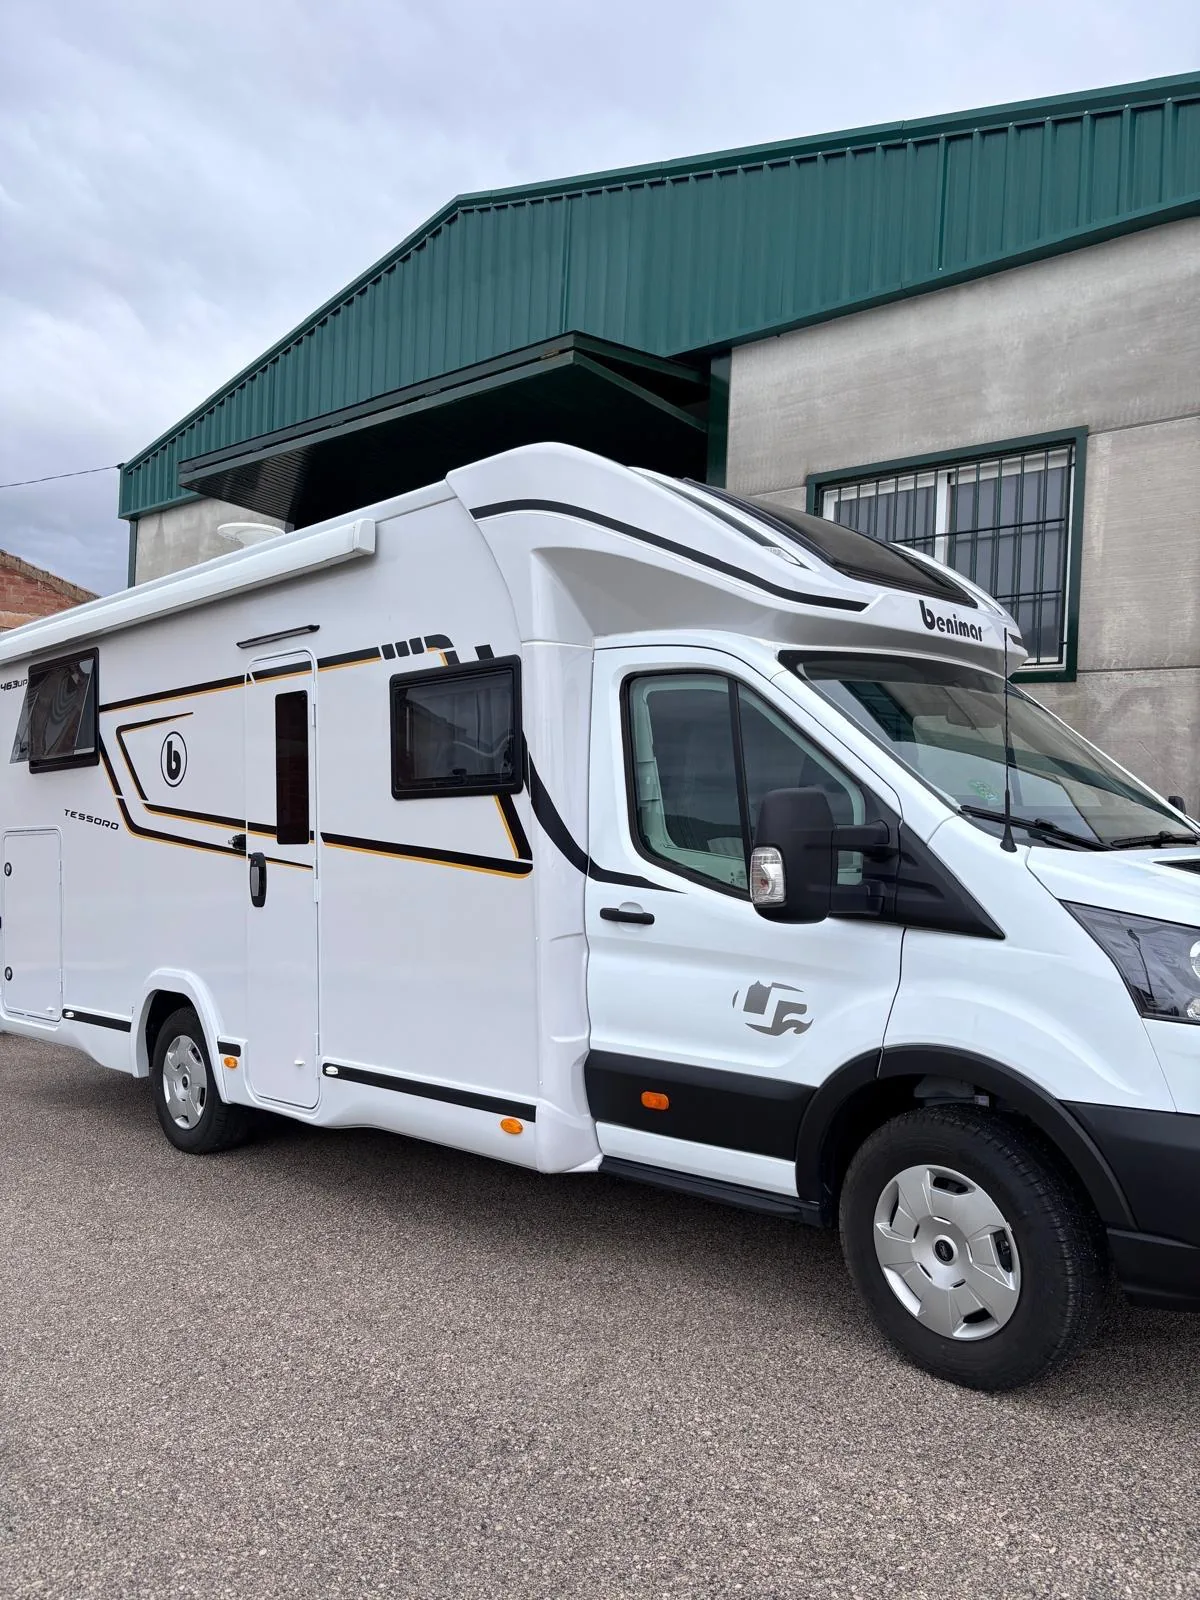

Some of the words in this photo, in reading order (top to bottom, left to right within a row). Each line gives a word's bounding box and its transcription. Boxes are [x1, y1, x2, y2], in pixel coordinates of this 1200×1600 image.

[919, 599, 983, 642] benimar
[166, 740, 182, 780] b
[64, 808, 119, 831] TESSORO
